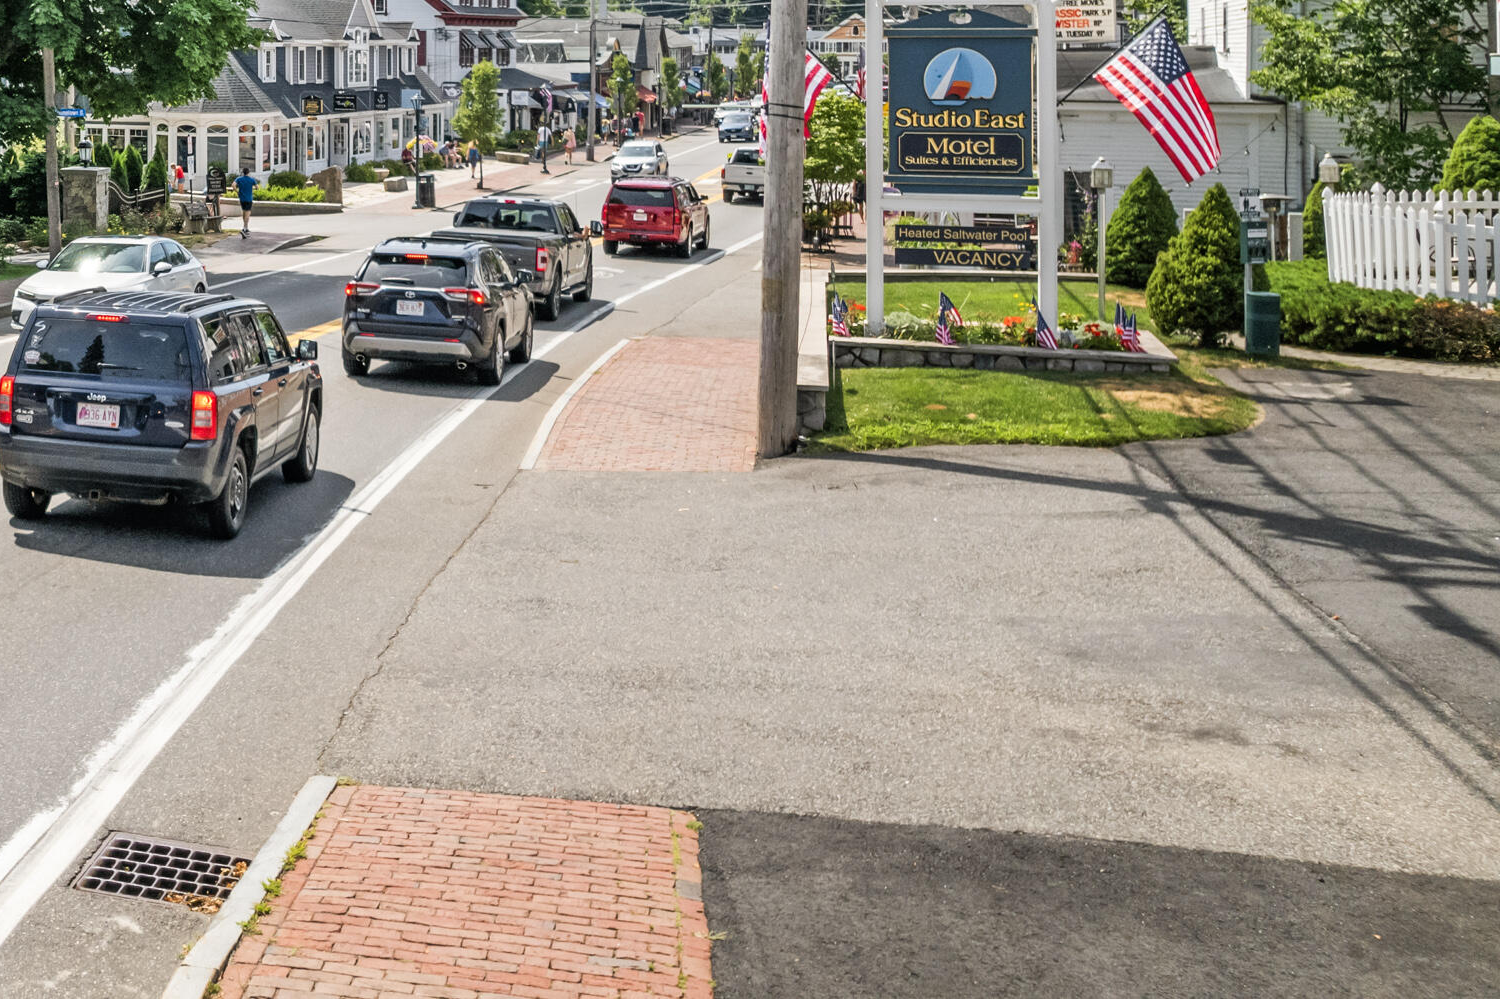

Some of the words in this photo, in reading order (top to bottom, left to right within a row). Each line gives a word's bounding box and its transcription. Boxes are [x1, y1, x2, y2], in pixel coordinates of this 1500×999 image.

[1082, 9, 1099, 17] PARK
[926, 136, 996, 155] Motel
[905, 155, 939, 165] Suites
[941, 156, 949, 165] &
[953, 156, 1018, 167] Efficiencies
[899, 227, 940, 239] Heated
[943, 228, 998, 241] Saltwater
[1001, 230, 1027, 241] Pool
[933, 250, 1024, 266] VACANCY
[87, 393, 107, 403] Jeep
